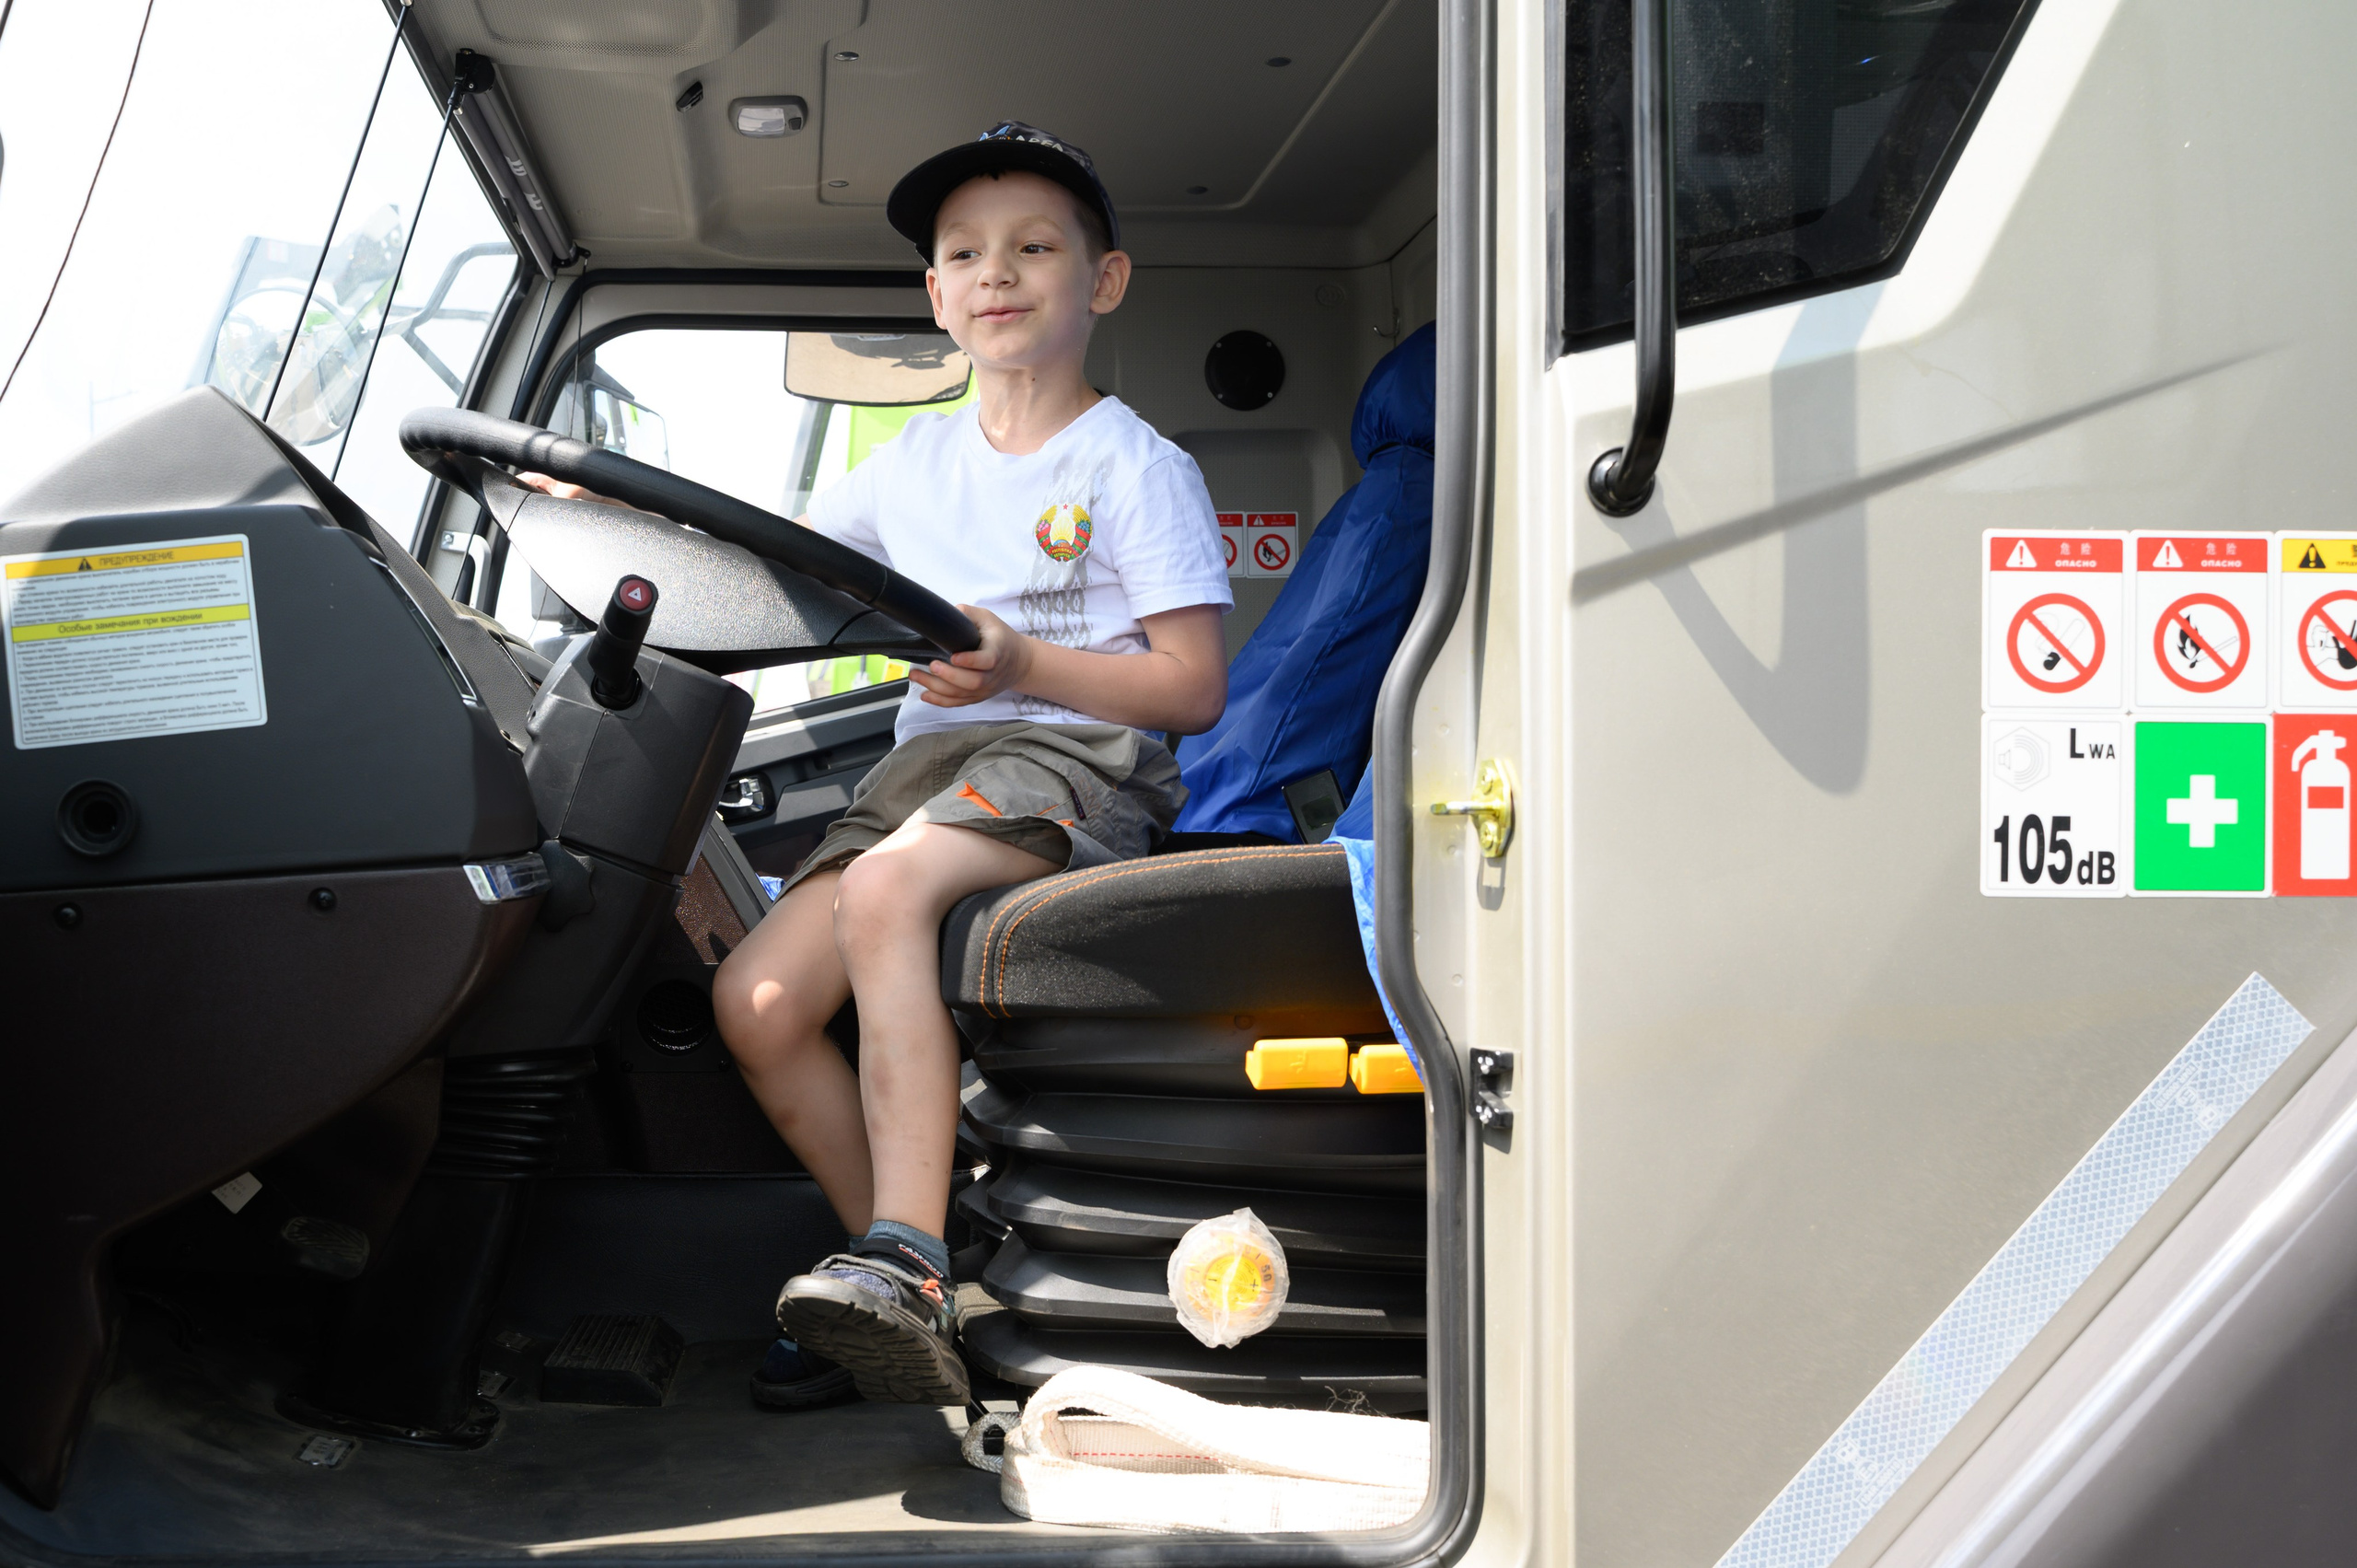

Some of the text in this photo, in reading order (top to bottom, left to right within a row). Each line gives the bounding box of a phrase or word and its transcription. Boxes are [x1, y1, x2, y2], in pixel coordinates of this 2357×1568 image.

[99, 552, 174, 566] ПРЕДУПРЕЖДЕНИЕ
[2055, 560, 2097, 568] ОПАСНО
[2200, 560, 2242, 568] ОПАСНО
[58, 613, 203, 633] Особые замечания при вождении
